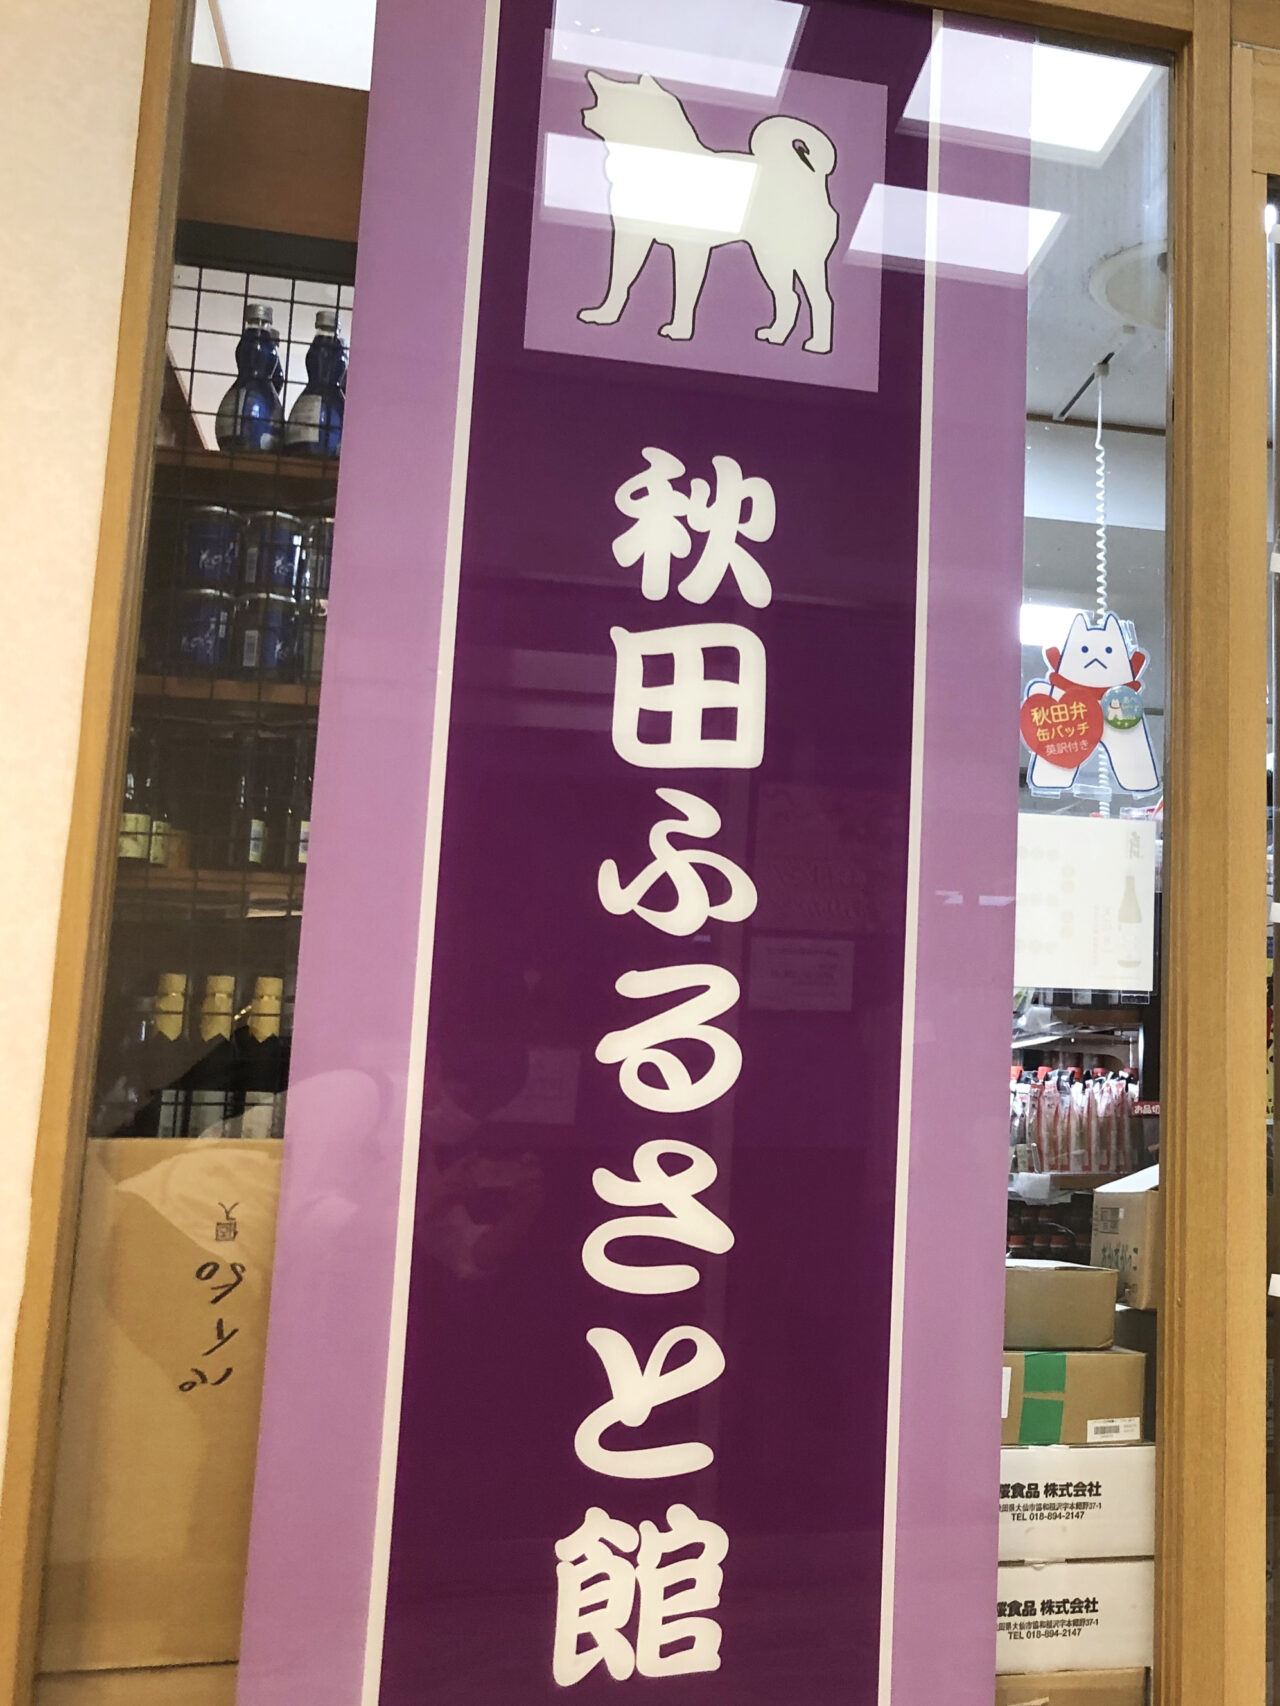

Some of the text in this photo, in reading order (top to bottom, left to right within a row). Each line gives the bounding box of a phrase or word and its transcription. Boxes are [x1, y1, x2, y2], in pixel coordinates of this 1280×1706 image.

[1030, 700, 1088, 727] 秋田弁
[553, 446, 777, 1687] 秋田ふるさと館
[1043, 1480, 1102, 1499] 株式会社
[1011, 1510, 1086, 1522] TEL 018-894-2147
[1040, 1596, 1099, 1616] 株式会社
[1008, 1628, 1082, 1640] TEL 018-894-2147
